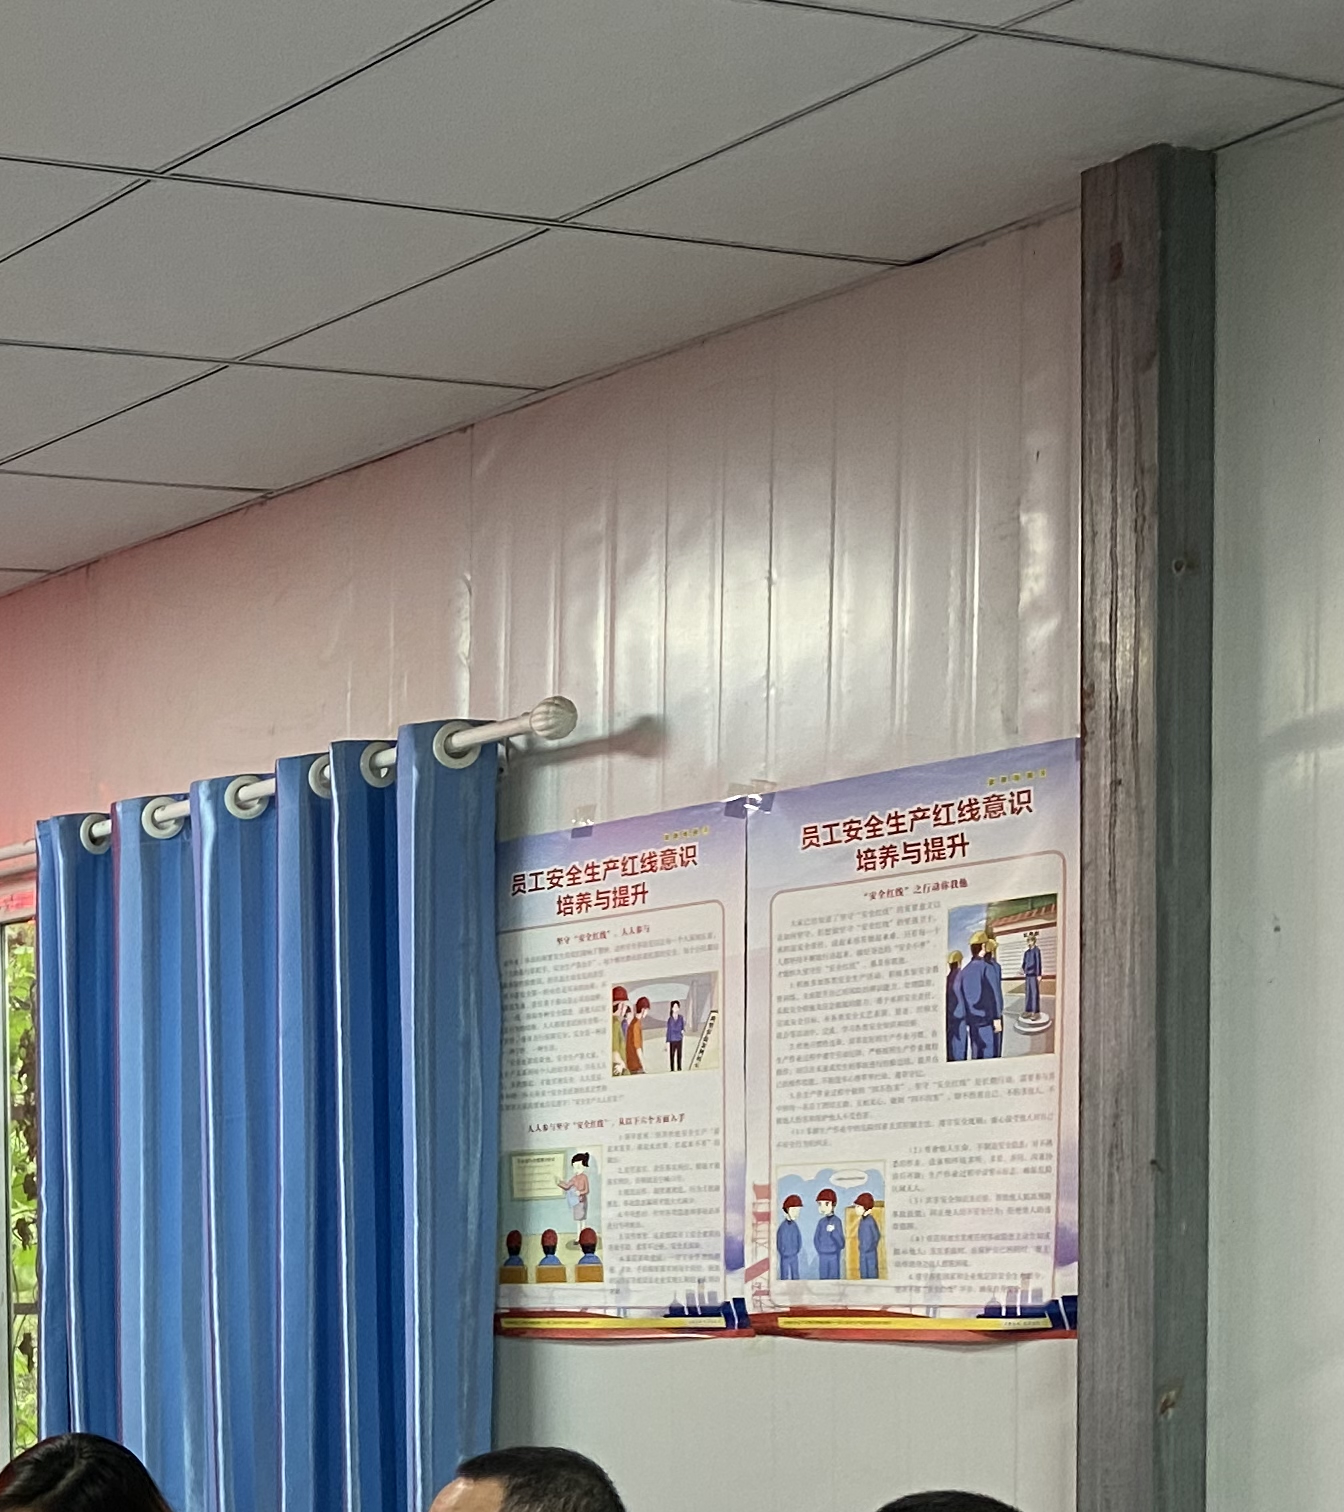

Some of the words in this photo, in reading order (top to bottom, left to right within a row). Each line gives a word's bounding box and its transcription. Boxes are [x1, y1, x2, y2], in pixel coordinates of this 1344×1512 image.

[801, 789, 1033, 850] 员工安全生产红线意识
[511, 845, 698, 896] 员工安全生产红线意识
[856, 832, 970, 872] 培养与提升
[556, 882, 649, 917] 培养与提升
